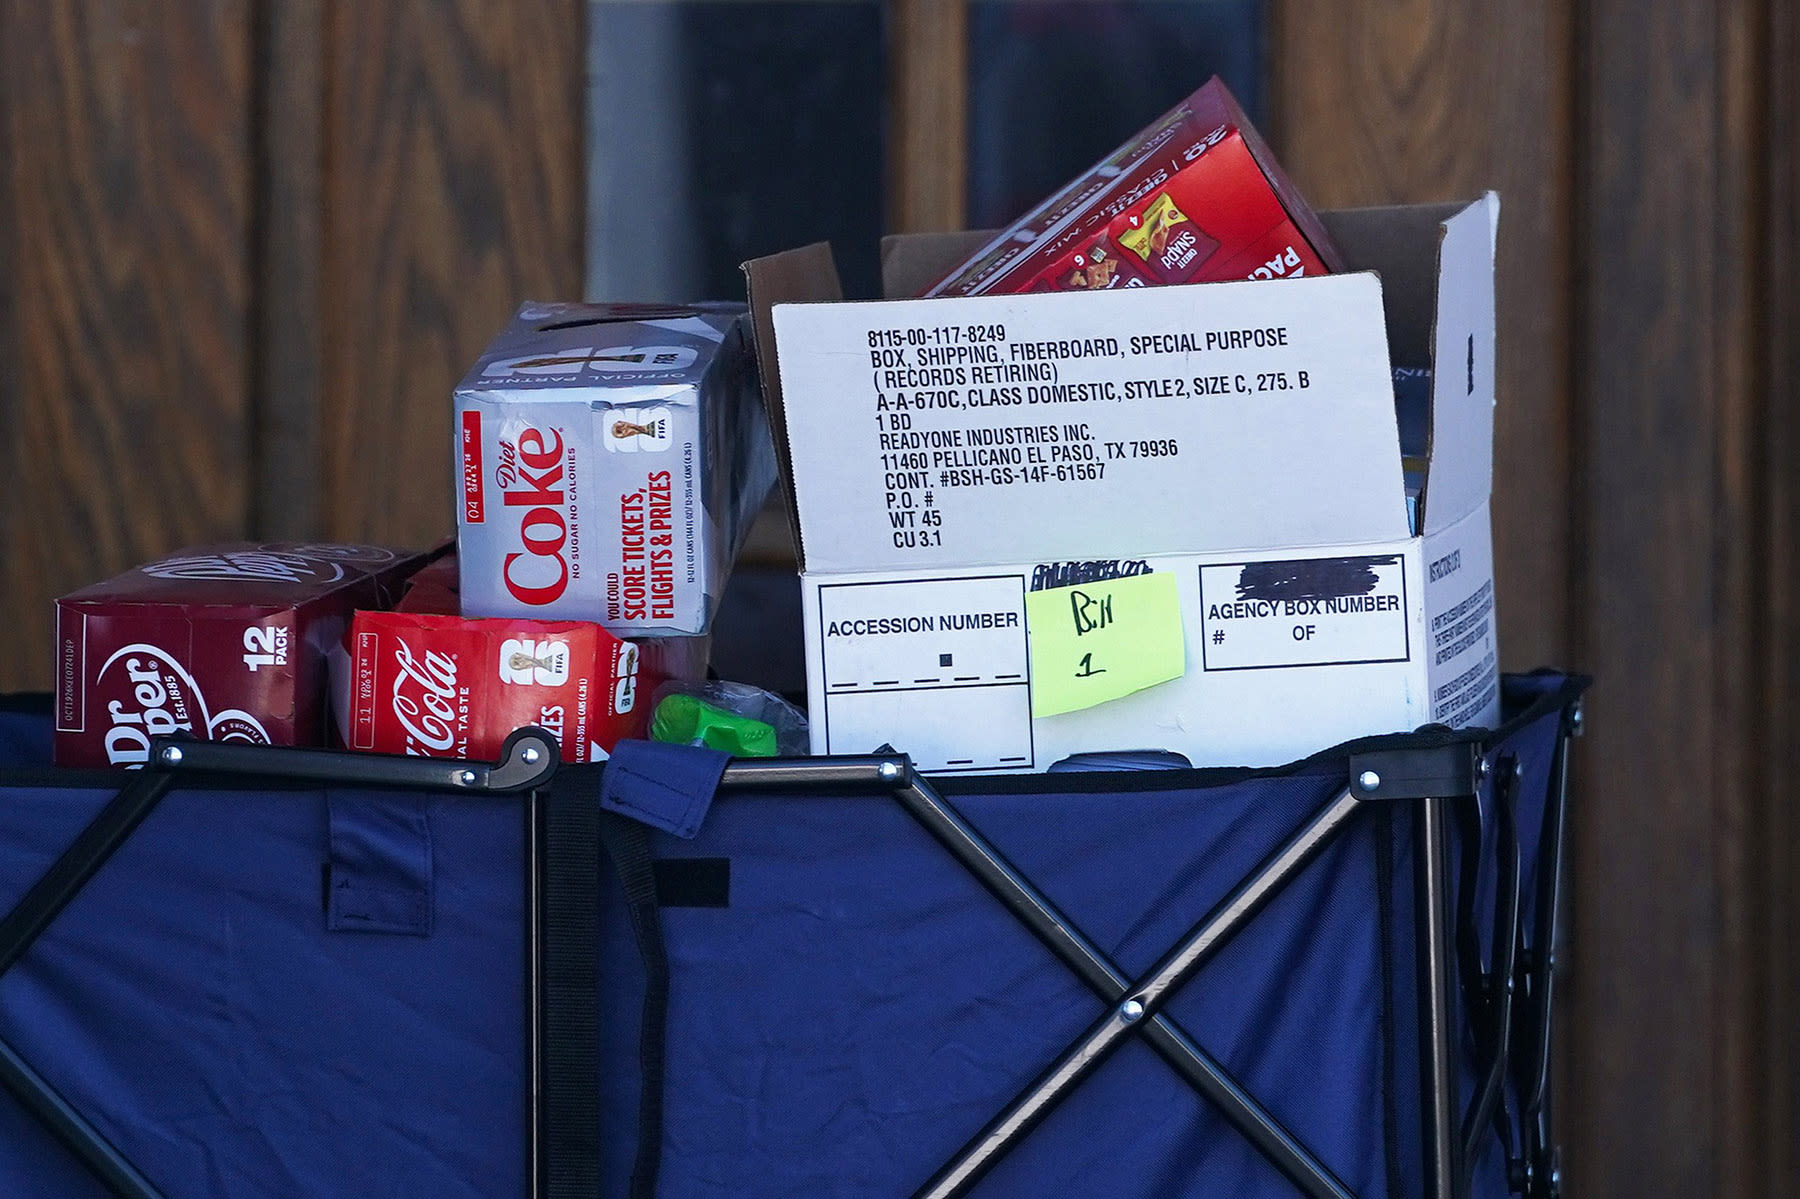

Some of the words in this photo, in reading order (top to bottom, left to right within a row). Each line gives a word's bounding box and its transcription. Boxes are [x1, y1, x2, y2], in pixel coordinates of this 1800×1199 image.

[1185, 130, 1227, 161] 20
[1086, 168, 1165, 227] CLASSIC
[1129, 216, 1138, 226] 4
[1045, 227, 1082, 257] MIX
[1074, 255, 1085, 266] 6
[1248, 246, 1301, 281] PAC
[868, 324, 1006, 348] 8115-00-117-8249
[871, 349, 912, 369] BOX,
[917, 345, 1005, 367] SHIPPING,
[1010, 338, 1125, 362] FIBERBOARD,
[1130, 333, 1202, 355] SPECIAL
[1206, 328, 1288, 351] PURPOSE
[972, 362, 1058, 385] RETIRING)
[1193, 376, 1231, 396] SIZE
[1235, 375, 1252, 395] C,
[1257, 373, 1294, 392] 275.
[1298, 371, 1310, 389] B
[657, 419, 666, 439] FIFA
[876, 414, 884, 432] 1
[890, 413, 912, 431] BD
[880, 430, 963, 451] READYONE
[966, 425, 1059, 447] INDUSTRIES
[1063, 424, 1096, 442] INC.
[496, 440, 517, 489] Diet
[881, 452, 929, 471] 11460
[933, 447, 1022, 468] PELLICANO
[1027, 447, 1047, 464] EL
[1051, 444, 1100, 463] PASO,
[1104, 442, 1126, 460] TX
[1129, 439, 1178, 458] 79936
[568, 447, 577, 501] CALORIES
[885, 472, 934, 491] CONT.
[940, 463, 1105, 488] #BSH-GS-14F-61567
[570, 504, 578, 520] NO
[648, 470, 672, 530] PRIZES
[886, 492, 919, 510] P.O.
[924, 491, 934, 508] #
[503, 425, 569, 606] Coke
[621, 488, 647, 563] TICKETS,
[889, 511, 916, 529] WT
[922, 510, 942, 527] 45
[571, 523, 579, 560] SUGAR
[650, 533, 672, 547] &
[893, 531, 916, 549] CU
[919, 530, 942, 548] 3.1
[572, 563, 580, 579] NO
[650, 549, 674, 619] FLIGHTS
[607, 572, 619, 601] COULD
[622, 565, 647, 621] SCORE
[607, 601, 620, 621] YOU
[1208, 601, 1281, 620] AGENCY
[1284, 599, 1322, 616] BOX
[1325, 595, 1400, 615] NUMBER
[827, 616, 934, 637] ACCESSION
[939, 612, 1019, 632] NUMBER
[1212, 629, 1226, 645] #
[1292, 625, 1316, 641] OF
[243, 626, 275, 672] 12
[275, 626, 288, 666] PACK
[555, 653, 564, 674] FIFA
[1075, 652, 1107, 677] 1
[126, 657, 193, 736] per
[393, 636, 458, 757] -Cola
[459, 687, 469, 731] TASTE
[104, 699, 151, 766] Dr
[541, 705, 564, 748] ZES
